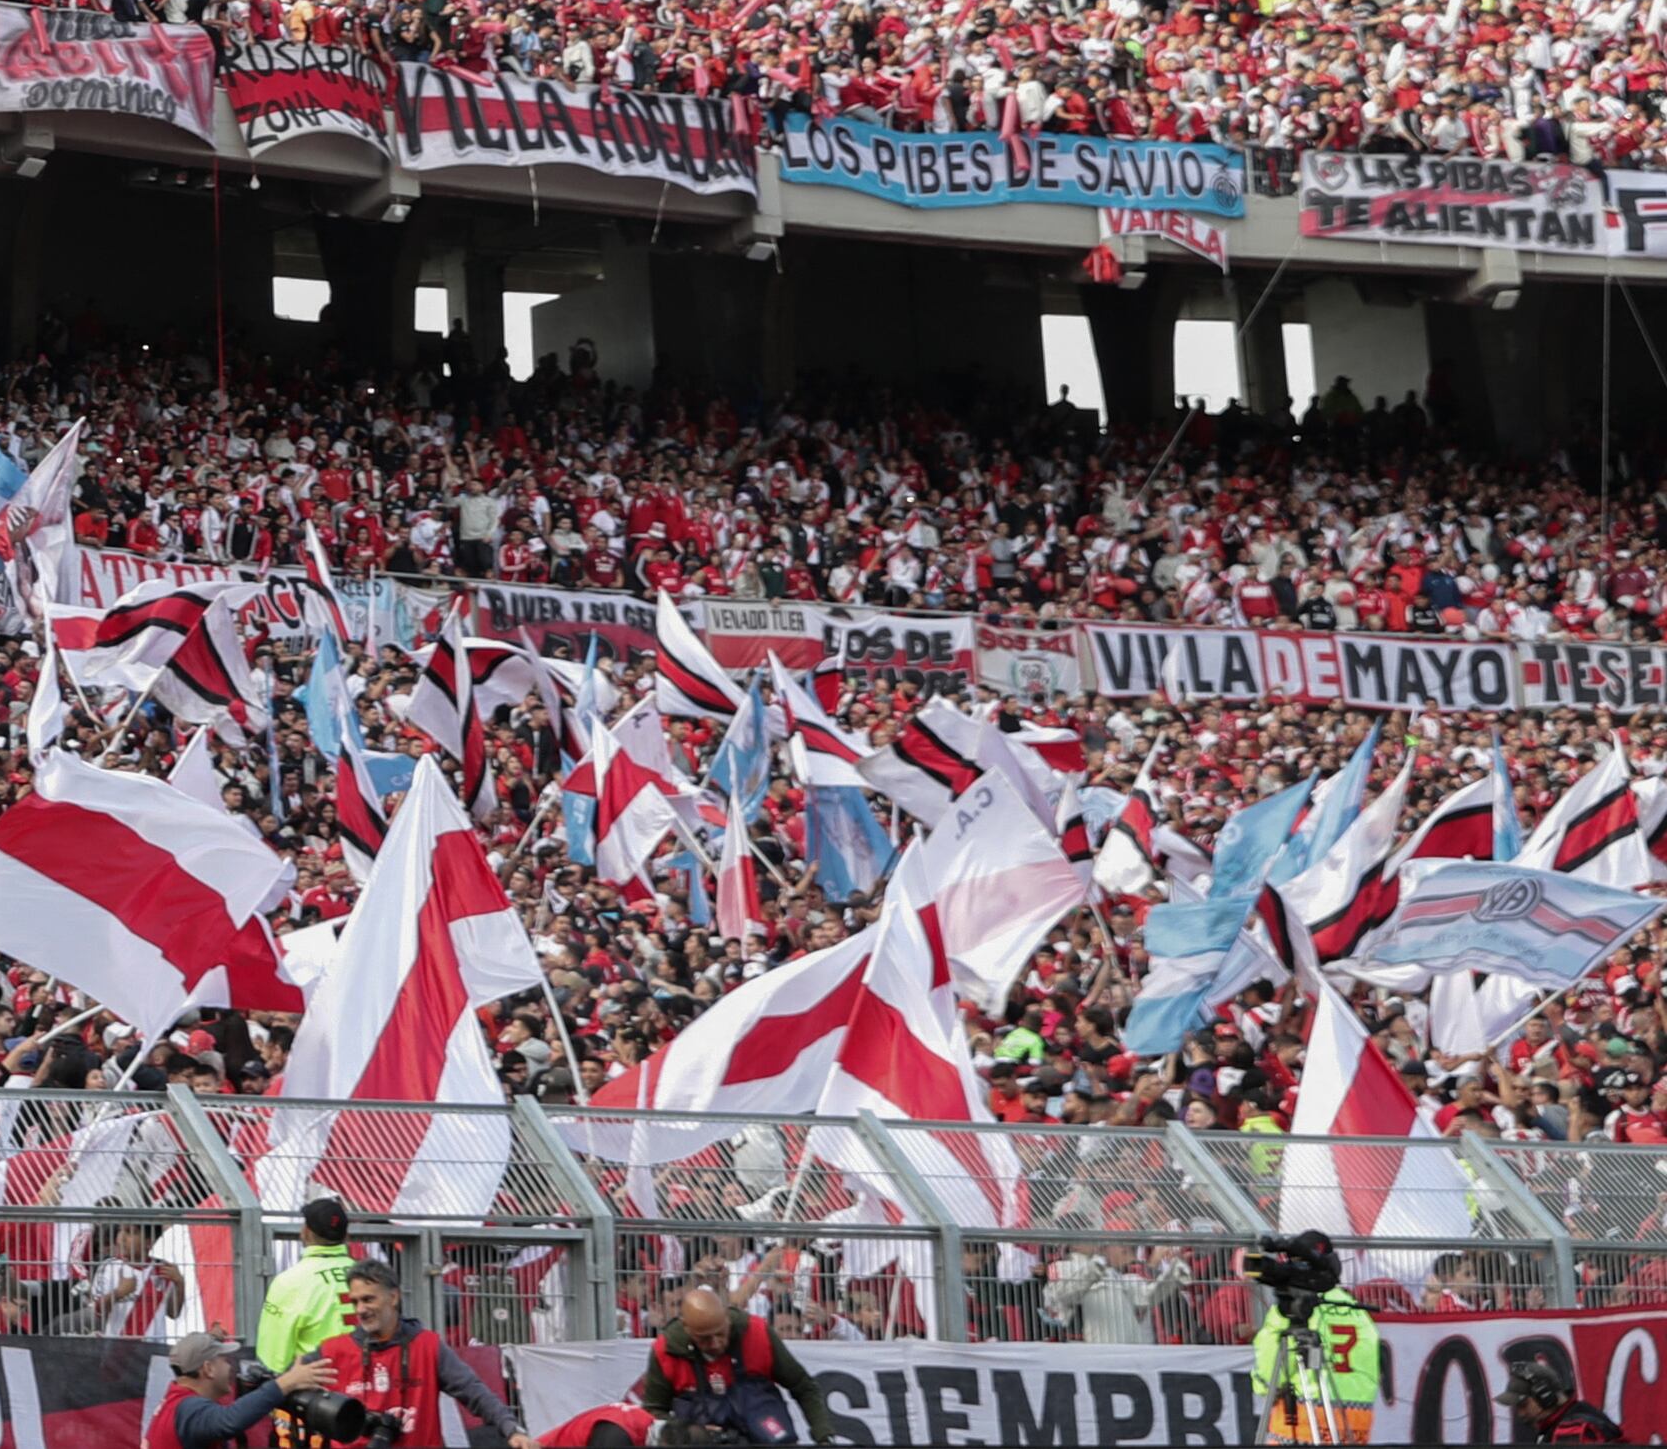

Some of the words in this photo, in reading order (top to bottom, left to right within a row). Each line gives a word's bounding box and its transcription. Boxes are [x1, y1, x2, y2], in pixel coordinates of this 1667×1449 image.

[244, 98, 338, 147] ZONA
[397, 62, 591, 158] VILLA
[782, 120, 863, 177] LOS
[871, 135, 994, 196] PIBES
[1006, 138, 1060, 190] DE
[1074, 142, 1206, 198] SAVIO
[1355, 156, 1420, 190] LAS
[1428, 160, 1533, 197] PIBAS
[1304, 187, 1371, 229] TE
[1381, 200, 1596, 248] ALIENTAN
[489, 588, 565, 632] RIVER
[572, 597, 586, 623] Y
[588, 597, 617, 625] SU
[712, 607, 767, 630] VENADO
[822, 622, 895, 662] LOS
[905, 629, 955, 664] DE
[1091, 629, 1261, 700] VILLA
[1275, 632, 1337, 700] DE
[1343, 638, 1511, 707] MAYO
[1534, 642, 1667, 708] TESE
[1328, 1324, 1358, 1374] 3
